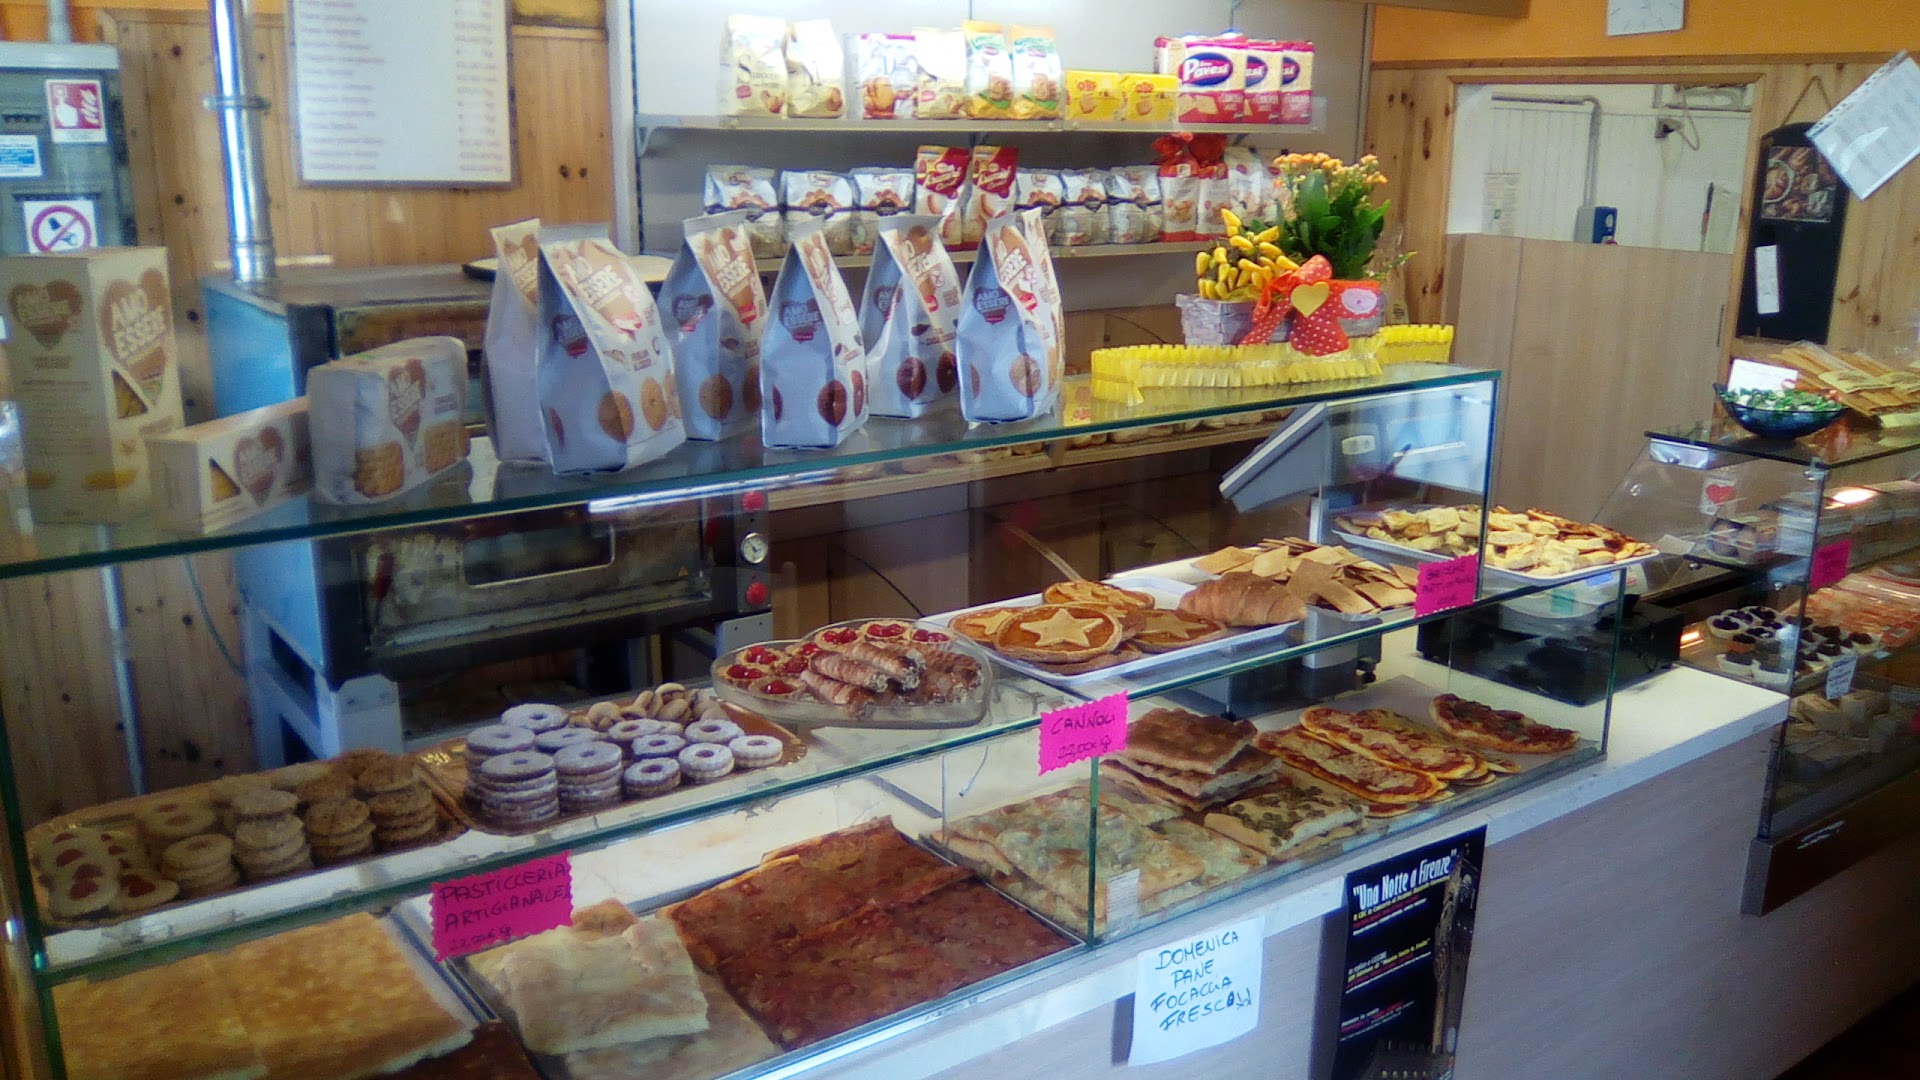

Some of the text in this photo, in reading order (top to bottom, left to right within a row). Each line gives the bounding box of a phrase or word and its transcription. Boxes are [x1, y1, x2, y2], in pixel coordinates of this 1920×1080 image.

[1182, 58, 1229, 81] Pavesi
[978, 291, 999, 307] AMO
[978, 297, 1009, 311] ESSERE
[114, 305, 166, 359] ESSERE
[440, 863, 566, 907] PASTICCERIA
[1382, 873, 1408, 901] Notte
[1410, 872, 1416, 889] a
[1155, 931, 1239, 970] DOMENICA
[1171, 959, 1214, 989] PANE
[1150, 976, 1232, 1013] FOCACCIA
